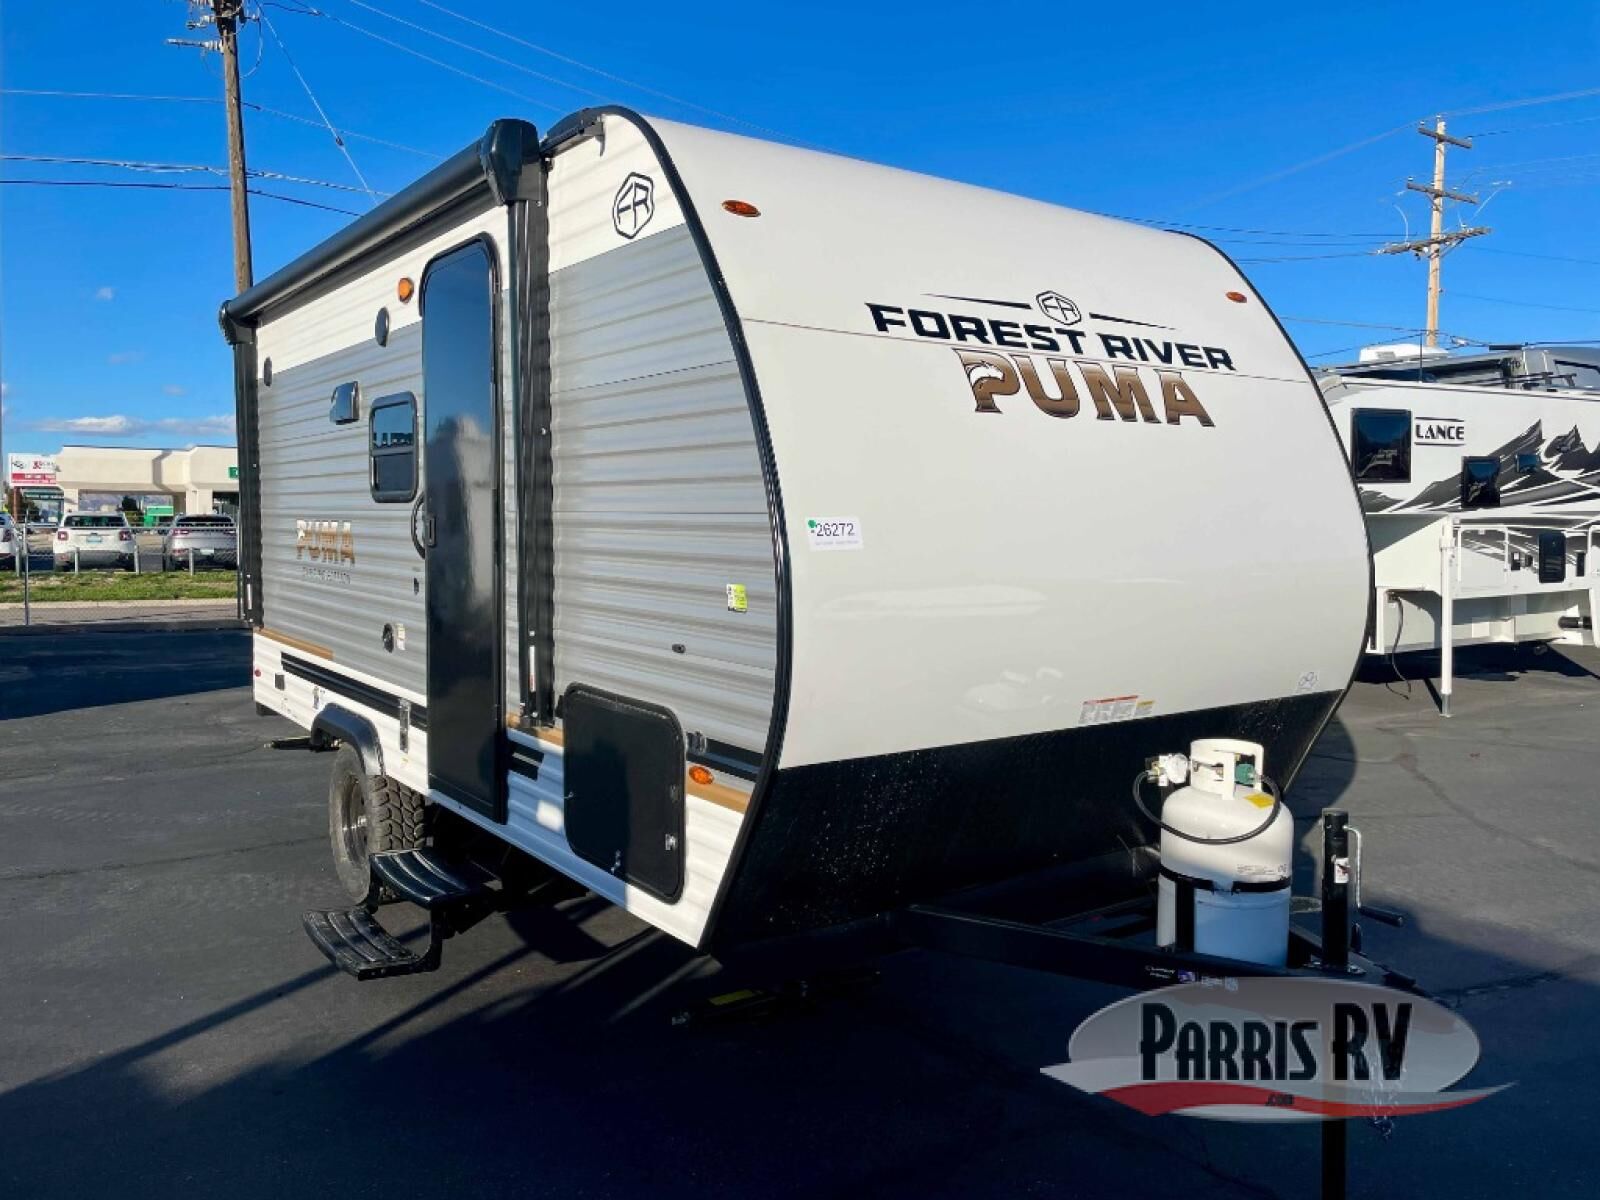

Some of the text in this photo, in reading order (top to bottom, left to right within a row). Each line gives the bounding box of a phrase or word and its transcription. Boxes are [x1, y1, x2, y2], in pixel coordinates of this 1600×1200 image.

[864, 302, 1237, 371] FOREST RIVER
[952, 347, 1216, 427] PUMA
[1415, 424, 1465, 440] LANCE
